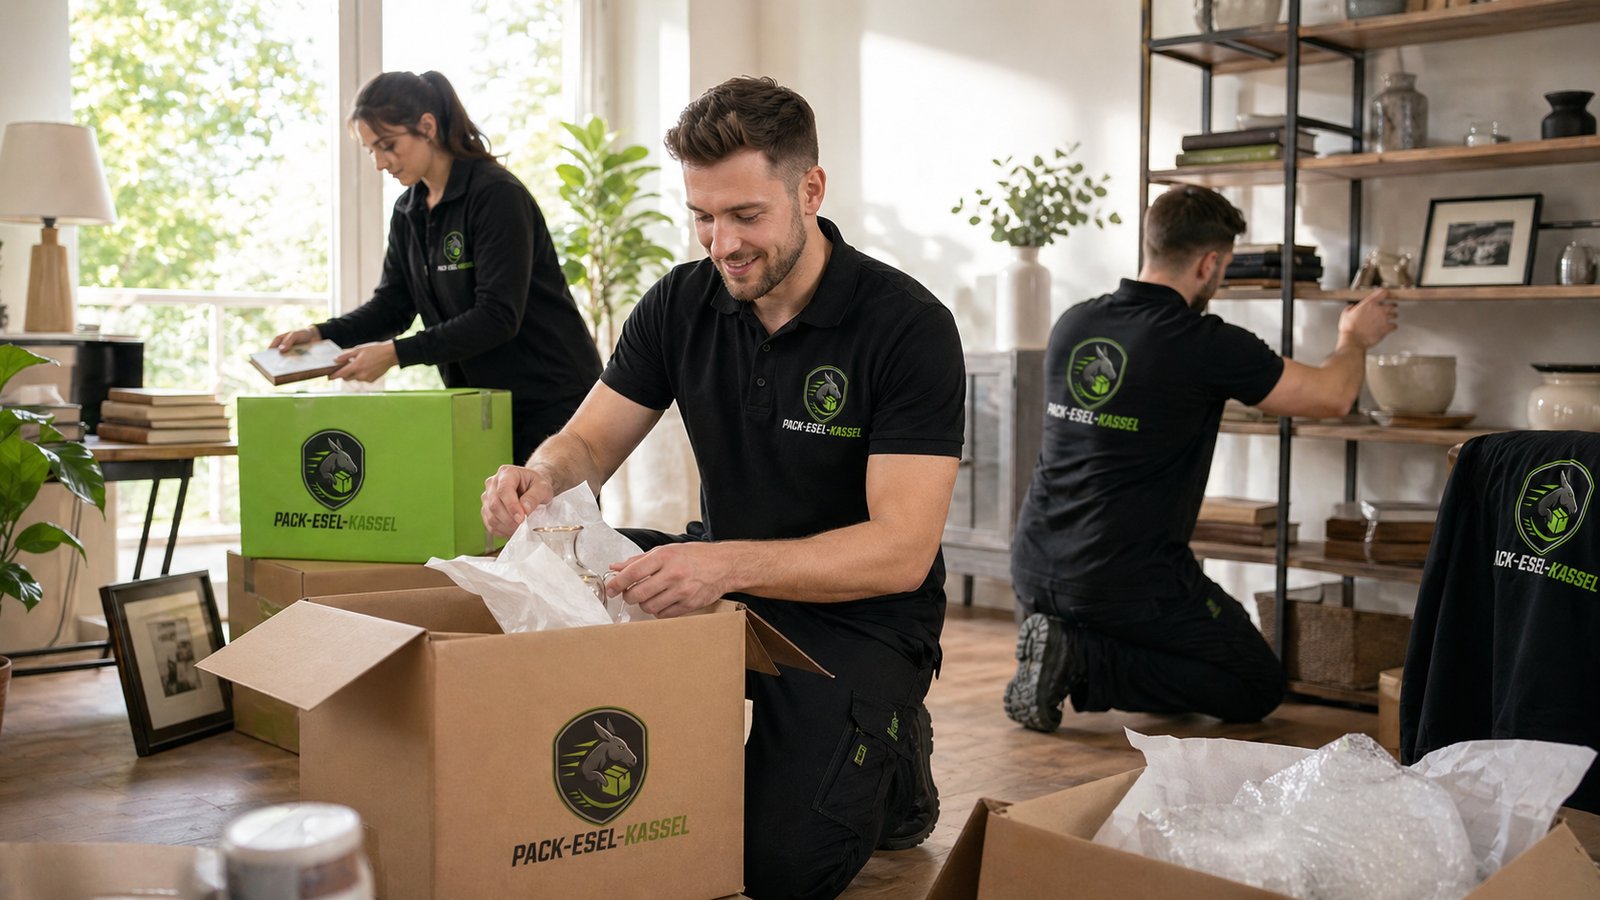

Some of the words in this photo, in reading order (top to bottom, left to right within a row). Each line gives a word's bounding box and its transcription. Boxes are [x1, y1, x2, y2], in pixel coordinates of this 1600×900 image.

[782, 418, 862, 438] PACK-ESEL-KASSEL
[1047, 402, 1139, 432] PACK-ESEL-KASSEL
[273, 511, 398, 532] PACK-ESEL-KASSEL
[1494, 549, 1599, 593] ACK-ESEL-KASSEL
[511, 814, 690, 868] PACK-ESEL-KASSEL
